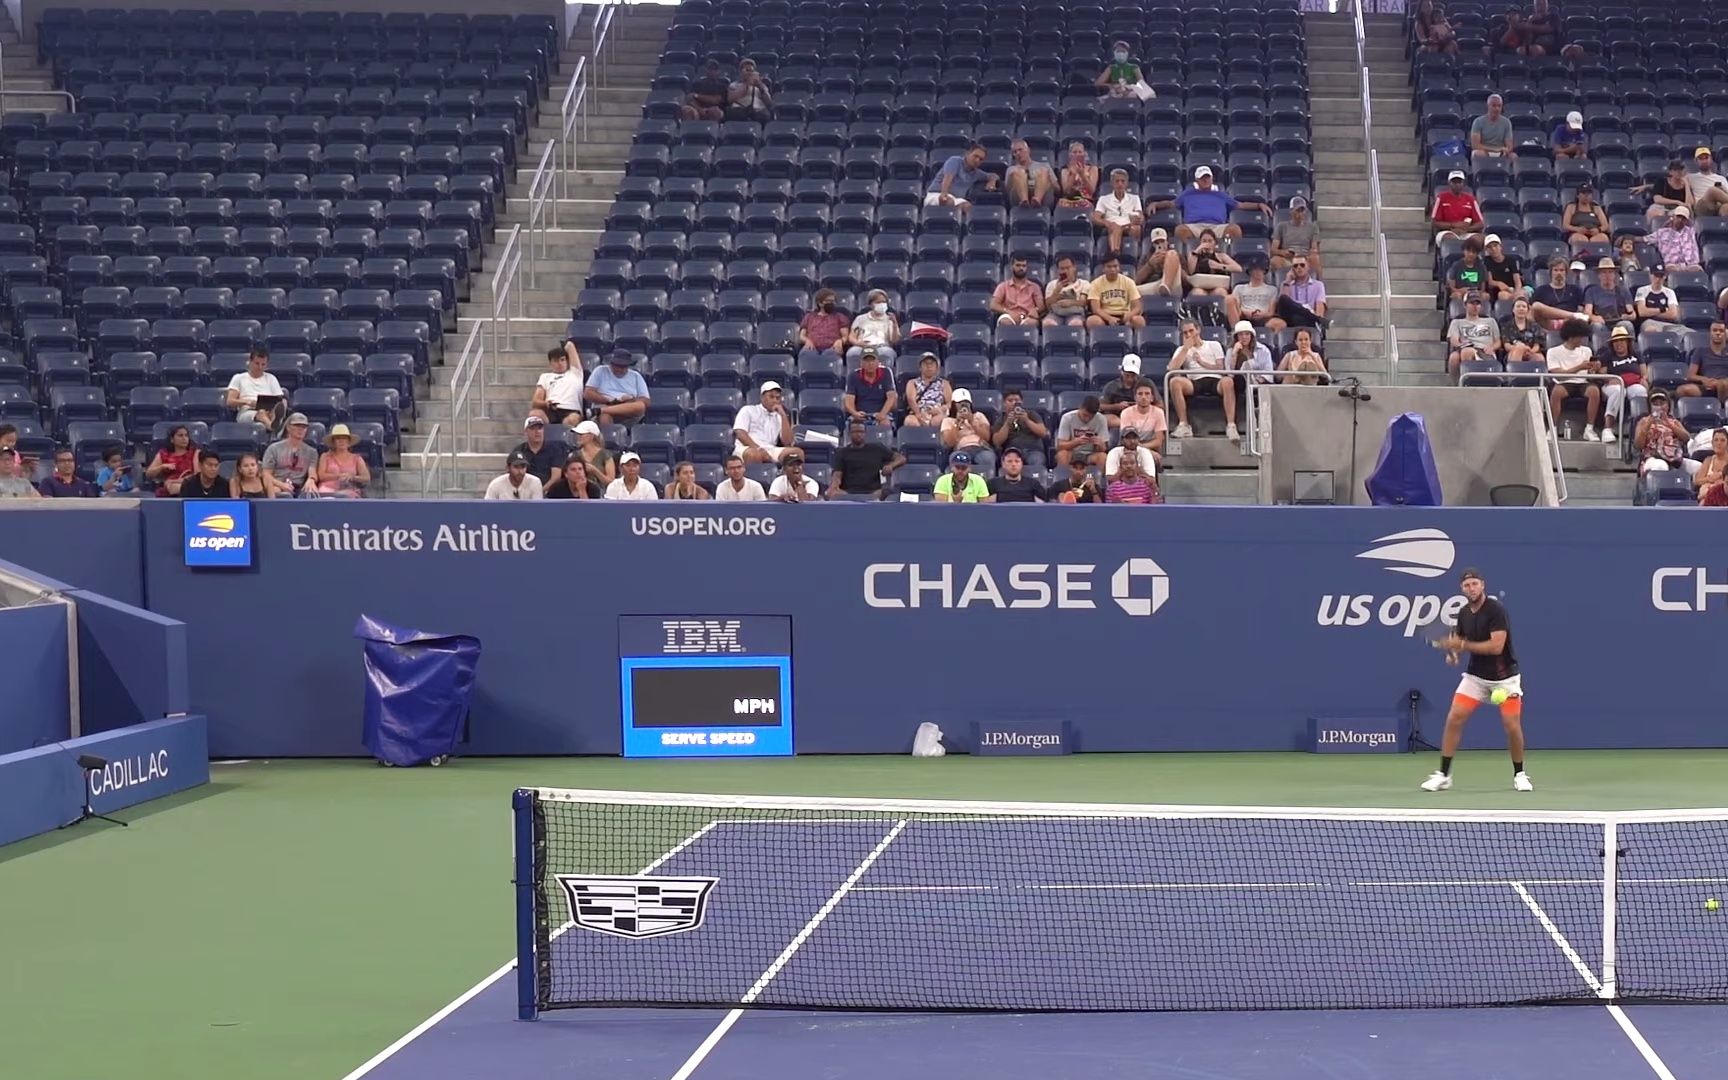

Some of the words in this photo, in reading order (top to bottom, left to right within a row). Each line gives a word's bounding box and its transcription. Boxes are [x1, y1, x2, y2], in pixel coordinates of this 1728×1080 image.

[631, 517, 776, 536] USOPEN.ORG
[189, 536, 207, 549] us
[207, 536, 245, 551] open
[290, 522, 424, 551] Emirates
[432, 523, 536, 551] Airline
[863, 563, 1097, 608] CHASE
[1316, 594, 1374, 626] us
[1378, 594, 1498, 637] ope
[662, 620, 742, 653] IBM
[733, 698, 775, 714] MPH
[661, 732, 706, 746] SERVE
[709, 732, 755, 746] SPEED
[981, 731, 1061, 749] J.P.Morgan
[1317, 729, 1397, 747] J.P.Morgan
[90, 749, 169, 796] CADILLAC
